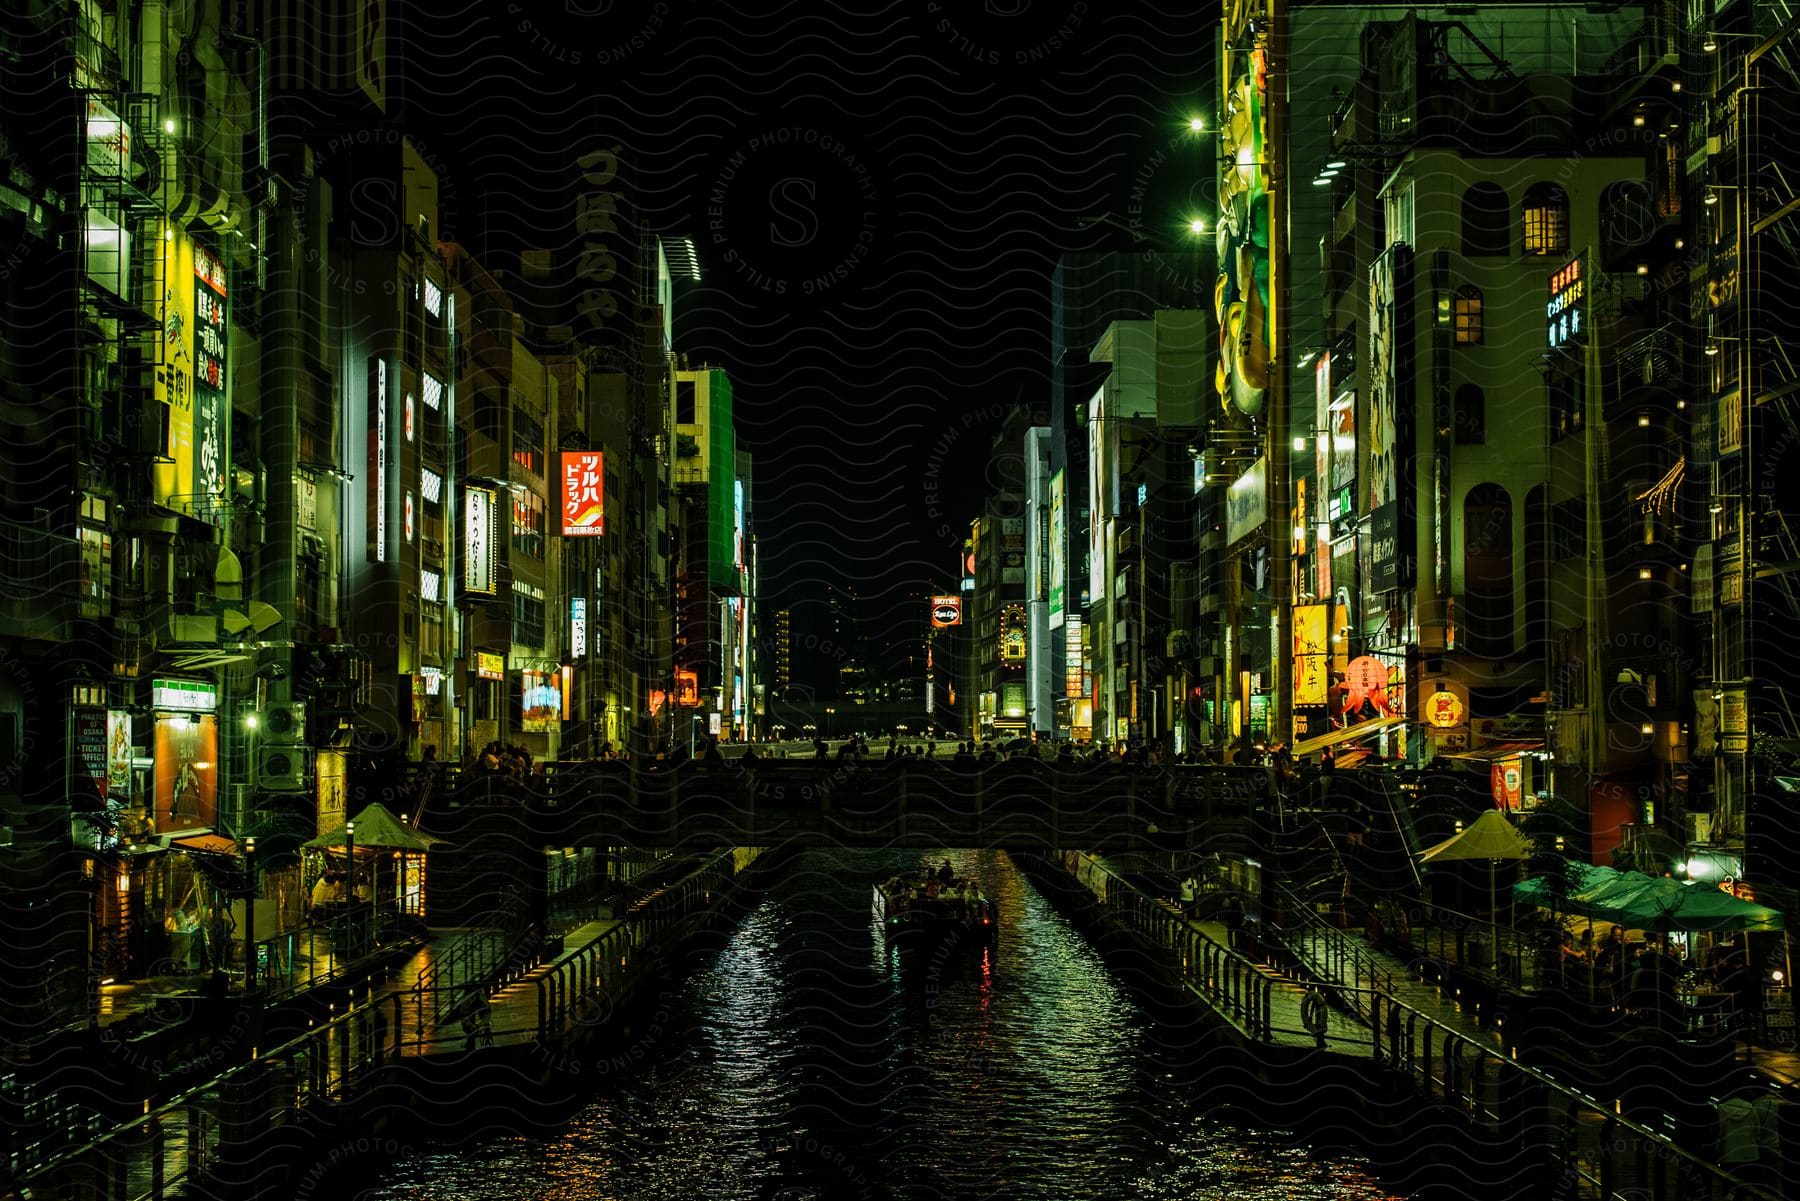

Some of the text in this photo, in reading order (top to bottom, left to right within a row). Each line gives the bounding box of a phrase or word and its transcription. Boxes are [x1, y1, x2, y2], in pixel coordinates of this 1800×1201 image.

[566, 464, 581, 515] ドラッグ
[582, 455, 600, 503] ツルハ
[81, 744, 106, 752] TICKET
[81, 753, 105, 761] OFFICE
